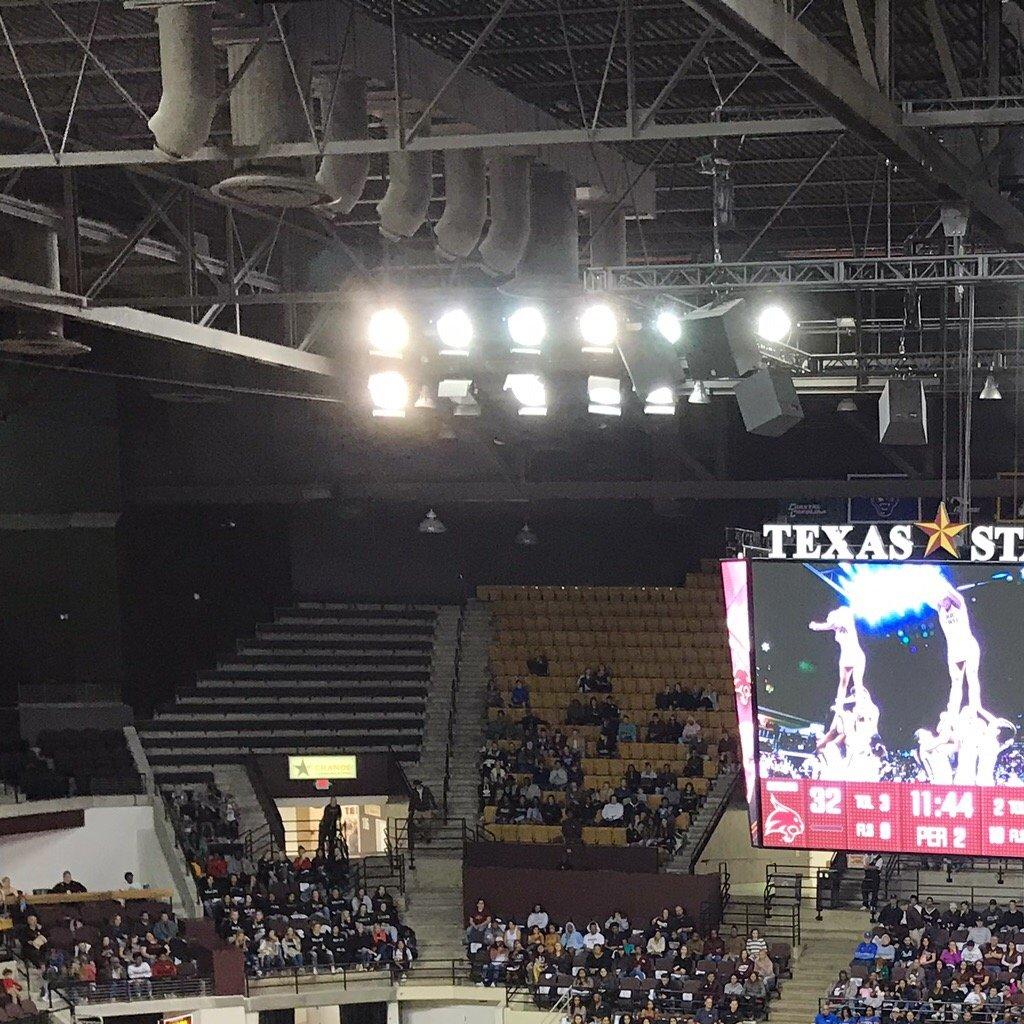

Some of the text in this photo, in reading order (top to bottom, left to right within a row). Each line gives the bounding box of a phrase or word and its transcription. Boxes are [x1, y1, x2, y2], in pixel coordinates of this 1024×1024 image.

[763, 523, 914, 561] TEXAS
[910, 790, 974, 818] 11:44
[917, 826, 966, 848] PER 2
